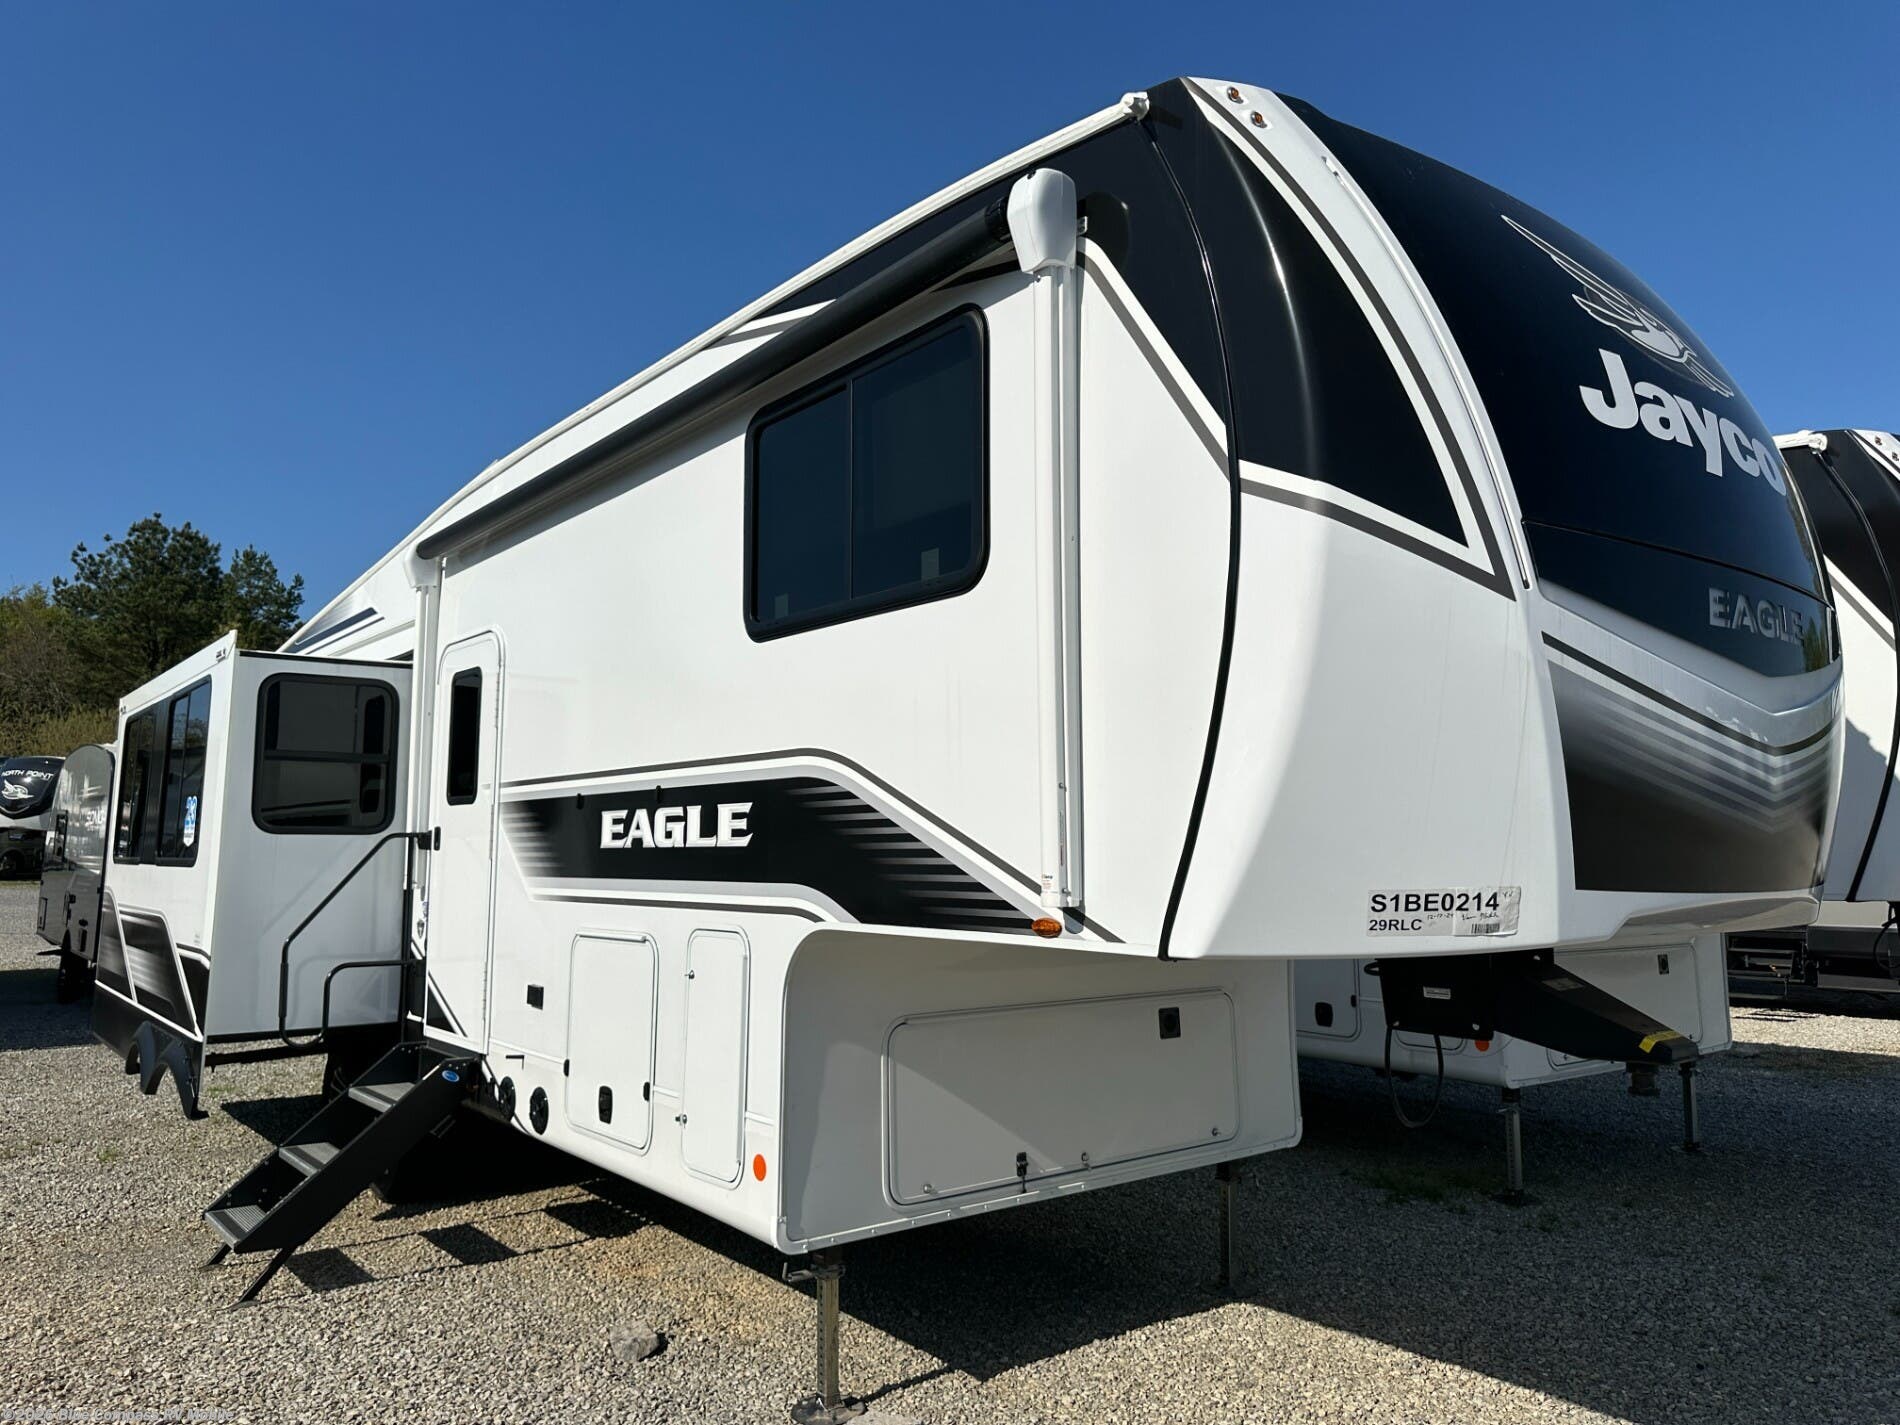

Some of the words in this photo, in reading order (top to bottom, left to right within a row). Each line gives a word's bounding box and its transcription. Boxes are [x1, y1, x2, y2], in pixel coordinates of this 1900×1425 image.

[1578, 348, 1787, 497] Jayco
[1708, 587, 1805, 645] EAGLE
[26, 770, 54, 780] POINT
[600, 802, 753, 848] EAGLE
[1370, 892, 1500, 912] S1BE0214
[1368, 918, 1423, 931] 29RLC
